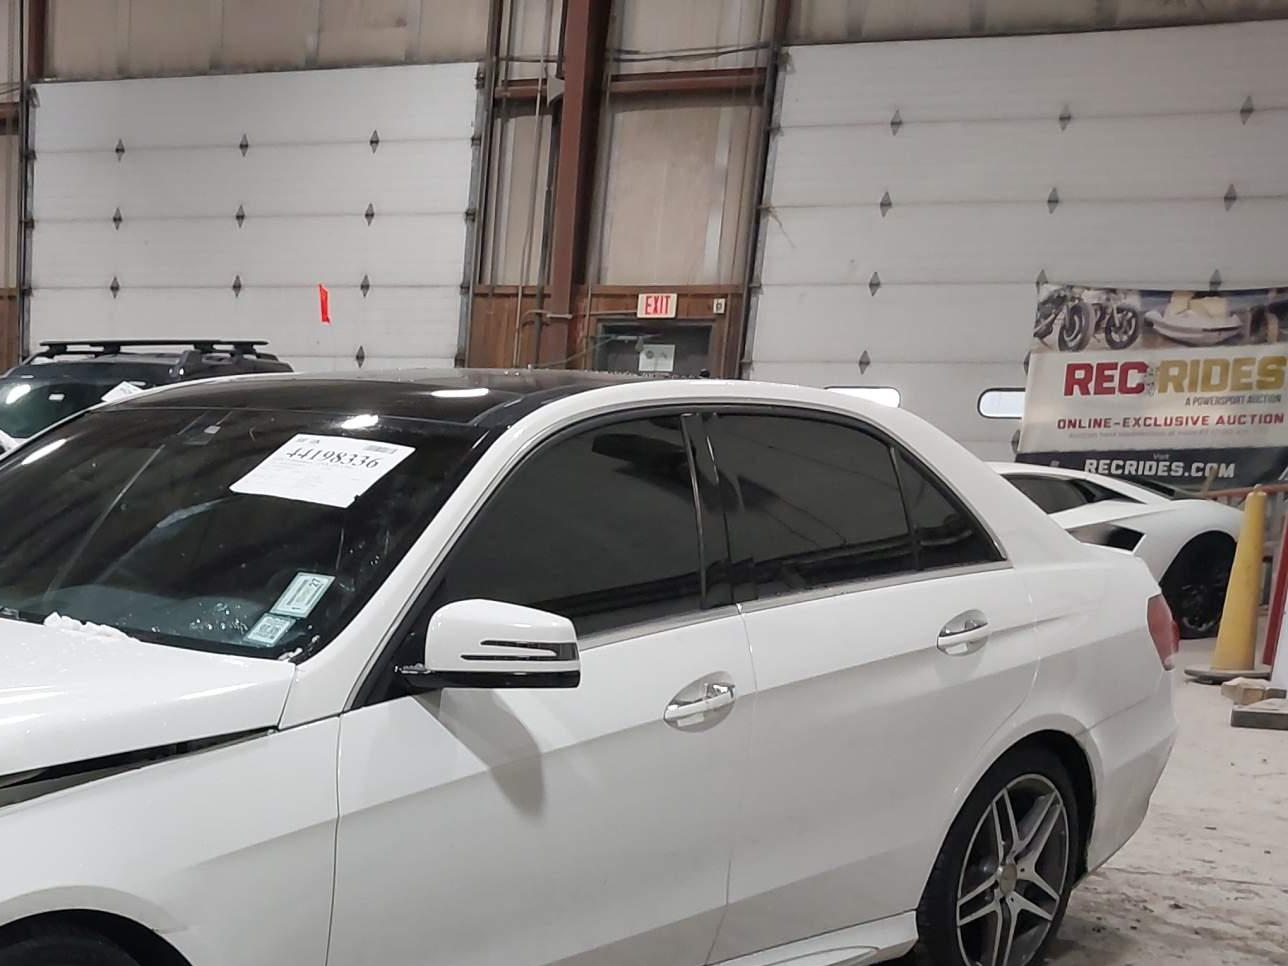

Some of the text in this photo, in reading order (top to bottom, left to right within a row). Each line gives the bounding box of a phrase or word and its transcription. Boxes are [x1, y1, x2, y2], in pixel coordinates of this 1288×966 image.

[644, 296, 670, 315] EXIT
[1064, 356, 1288, 396] REC RIDES
[1247, 392, 1282, 404] AUCTION
[1057, 413, 1284, 430] ONLINE-EXCLUSIVE AUCTION
[286, 446, 381, 469] 44198336
[1084, 459, 1235, 478] RECRIDES.COM
